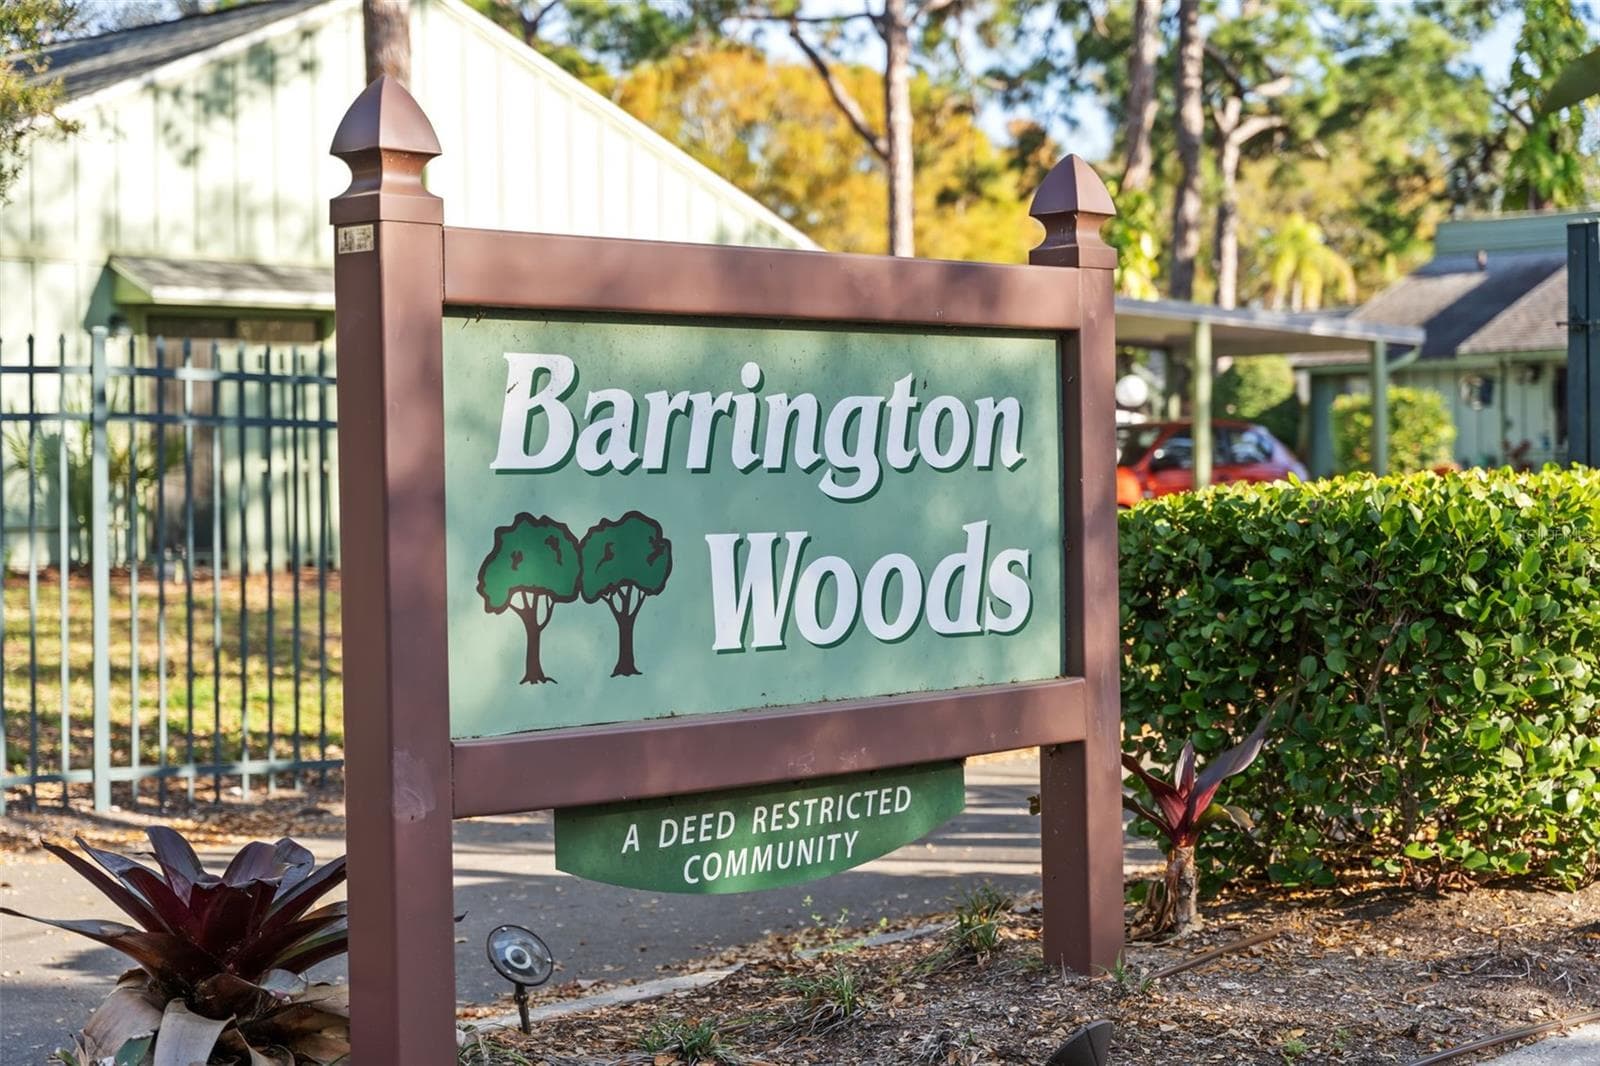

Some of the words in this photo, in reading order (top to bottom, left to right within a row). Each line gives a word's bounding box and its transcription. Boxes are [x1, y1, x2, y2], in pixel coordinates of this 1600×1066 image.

[490, 352, 1026, 502] Barrington
[705, 520, 1033, 652] Woods
[621, 823, 640, 854] A
[658, 810, 736, 849] DEED
[751, 785, 912, 834] RESTRICTED
[683, 830, 859, 884] COMMUNITY
